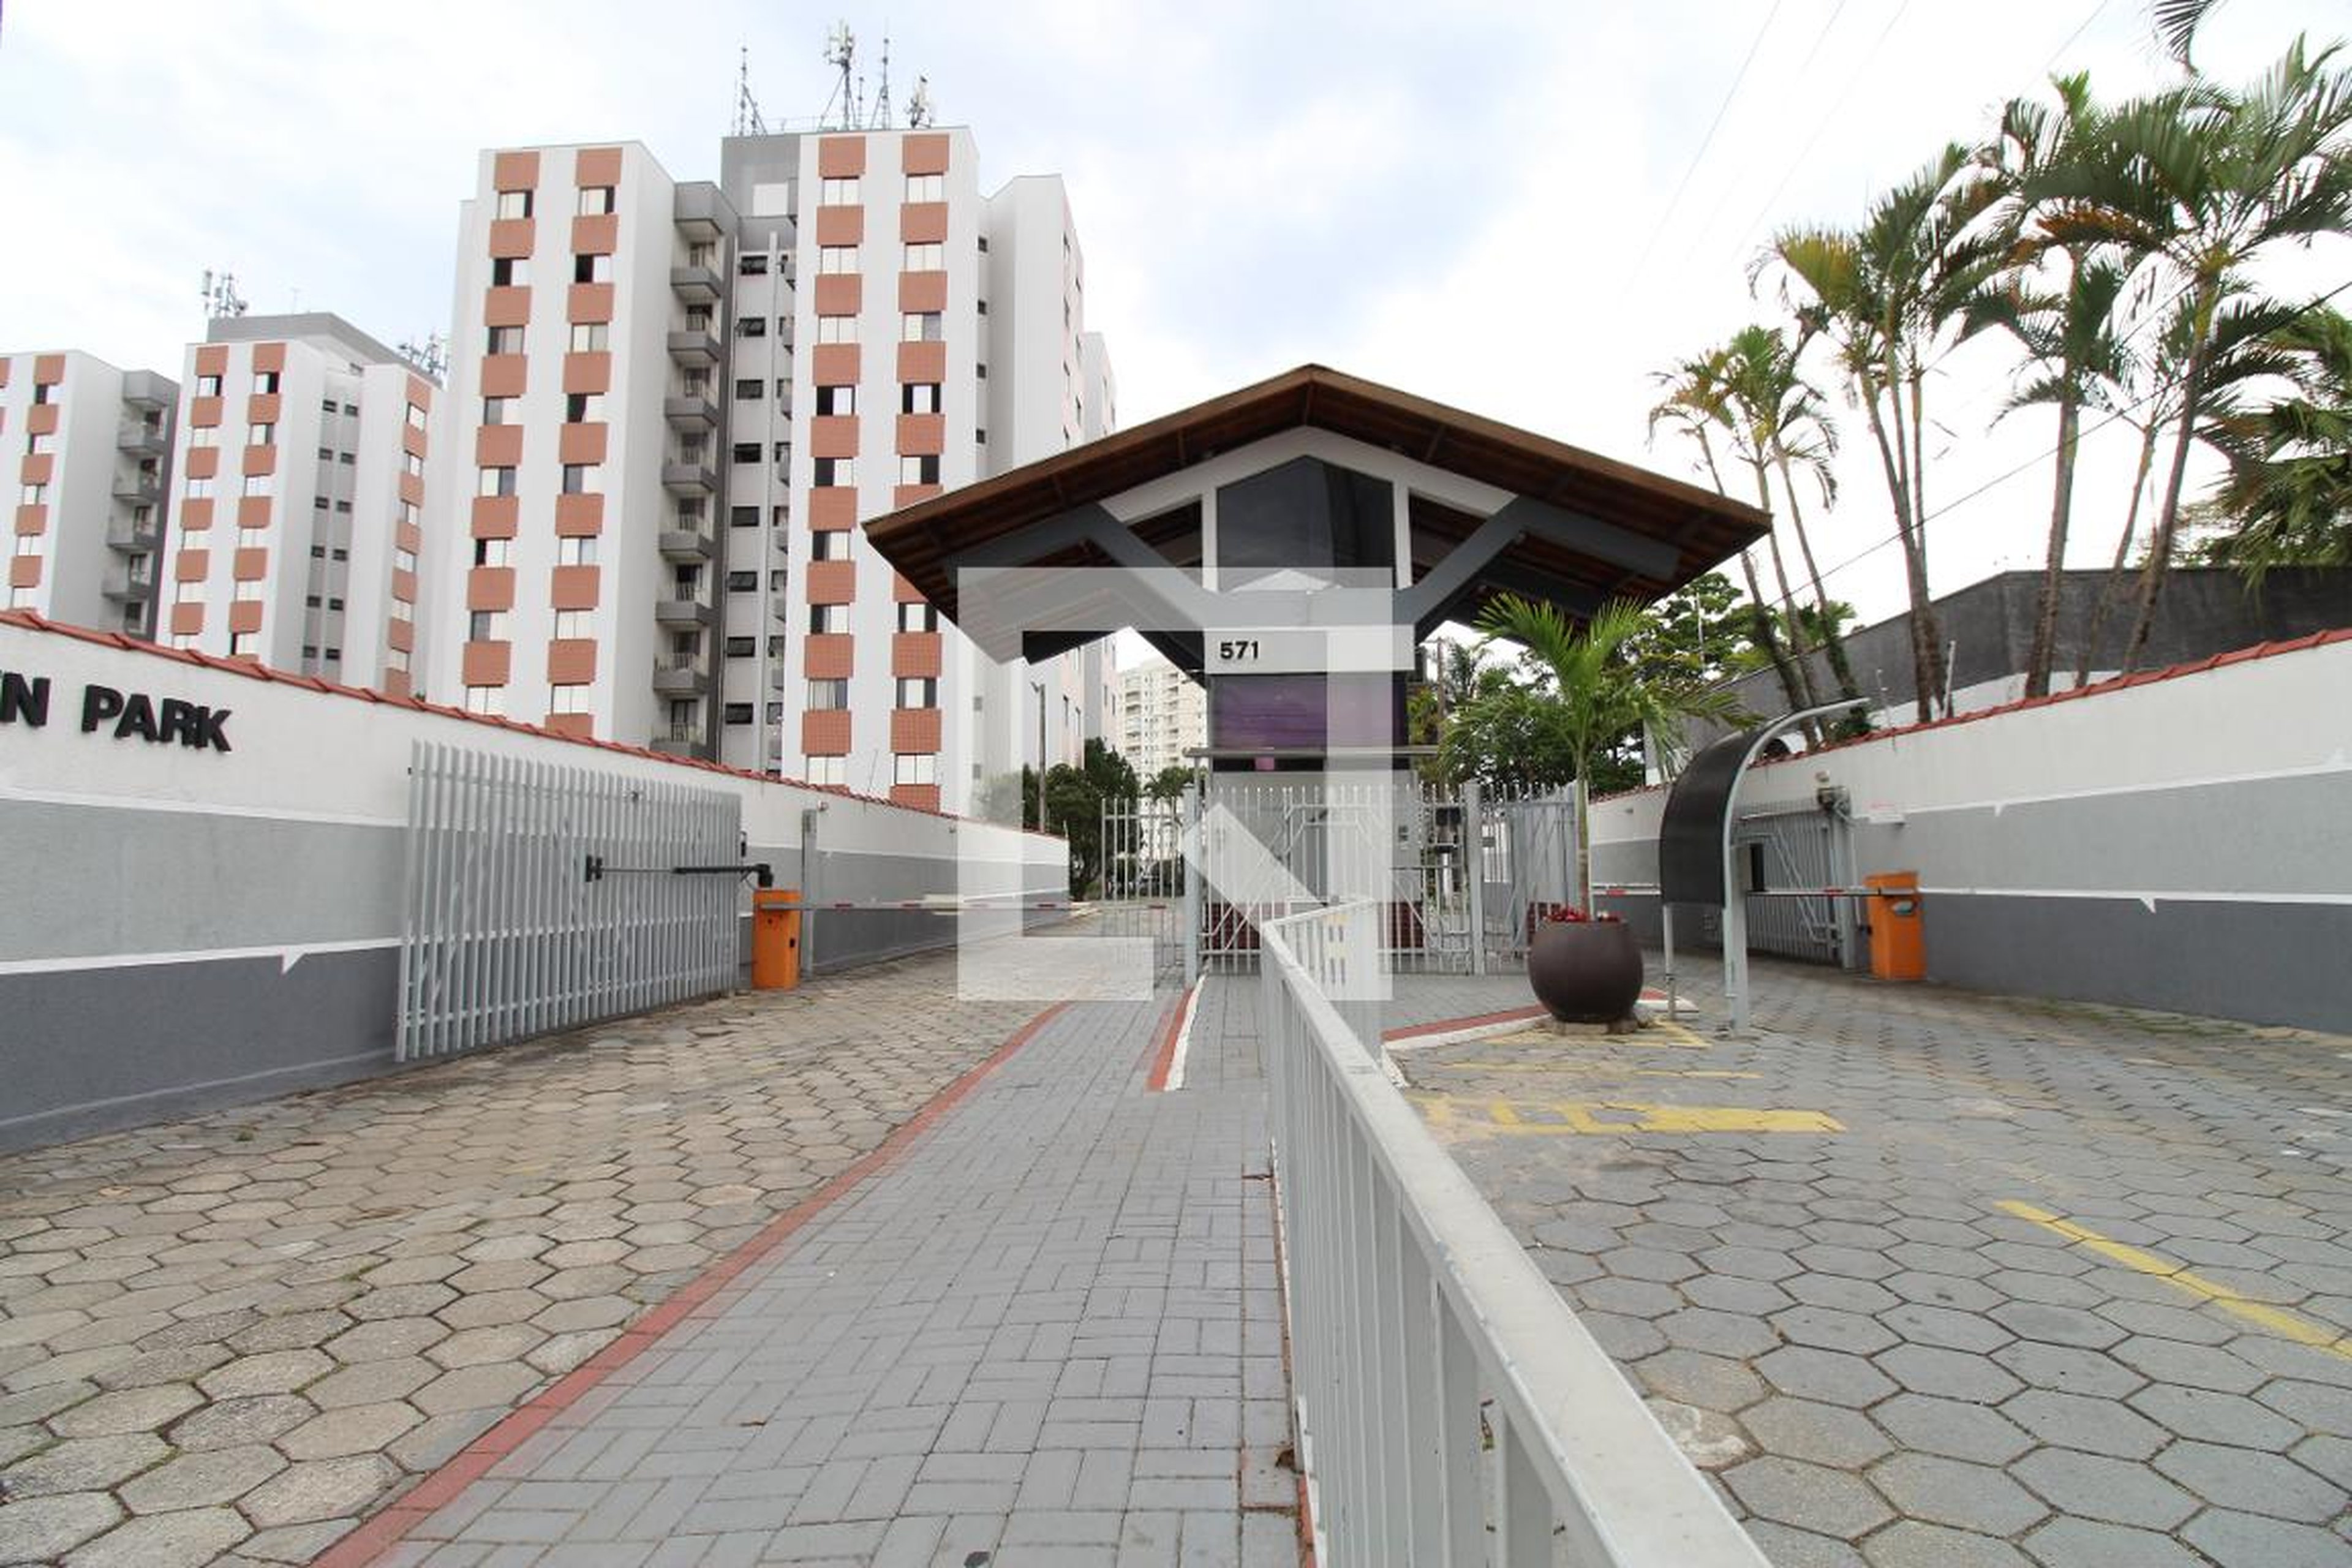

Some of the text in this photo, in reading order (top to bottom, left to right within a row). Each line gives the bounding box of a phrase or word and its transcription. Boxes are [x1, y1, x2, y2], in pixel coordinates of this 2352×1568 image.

[1221, 641, 1259, 660] 571
[0, 669, 232, 752] N PARK
